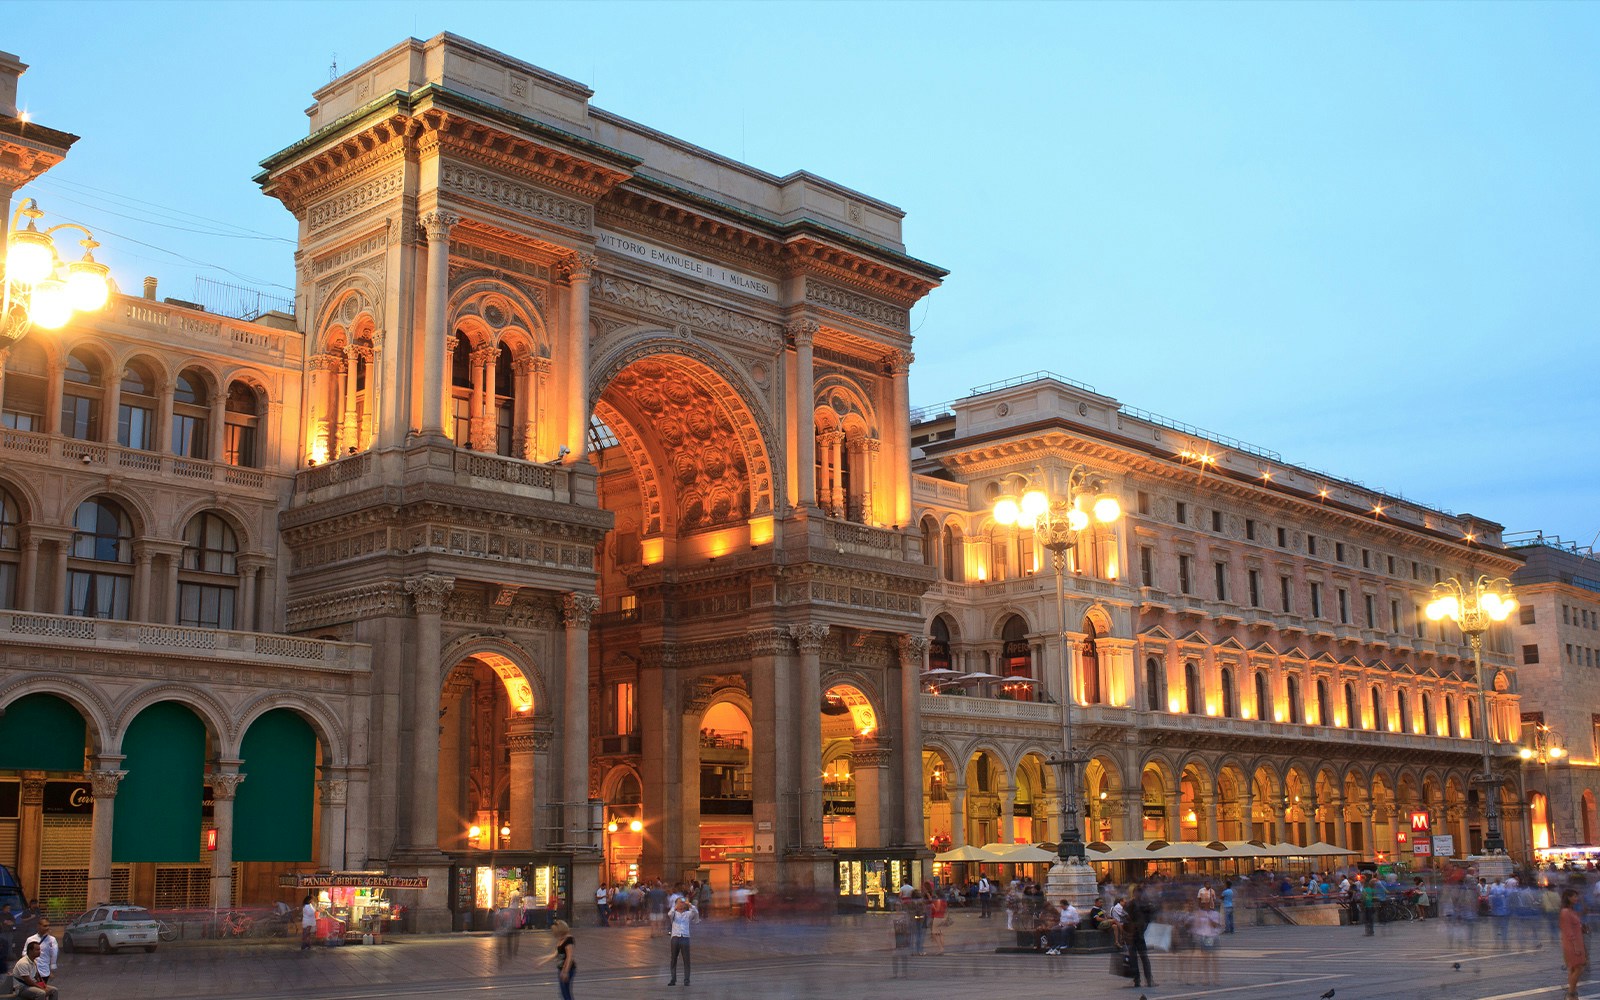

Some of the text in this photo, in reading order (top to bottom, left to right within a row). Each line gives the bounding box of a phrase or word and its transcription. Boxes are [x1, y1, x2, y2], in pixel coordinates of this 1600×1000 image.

[600, 232, 646, 256] VITTORIO
[651, 249, 702, 274] EMANUELE
[729, 274, 769, 294] MILANESI
[1412, 815, 1428, 829] M
[1397, 833, 1406, 842] M
[337, 876, 362, 886] BIBITE
[401, 877, 423, 888] PIZZA
